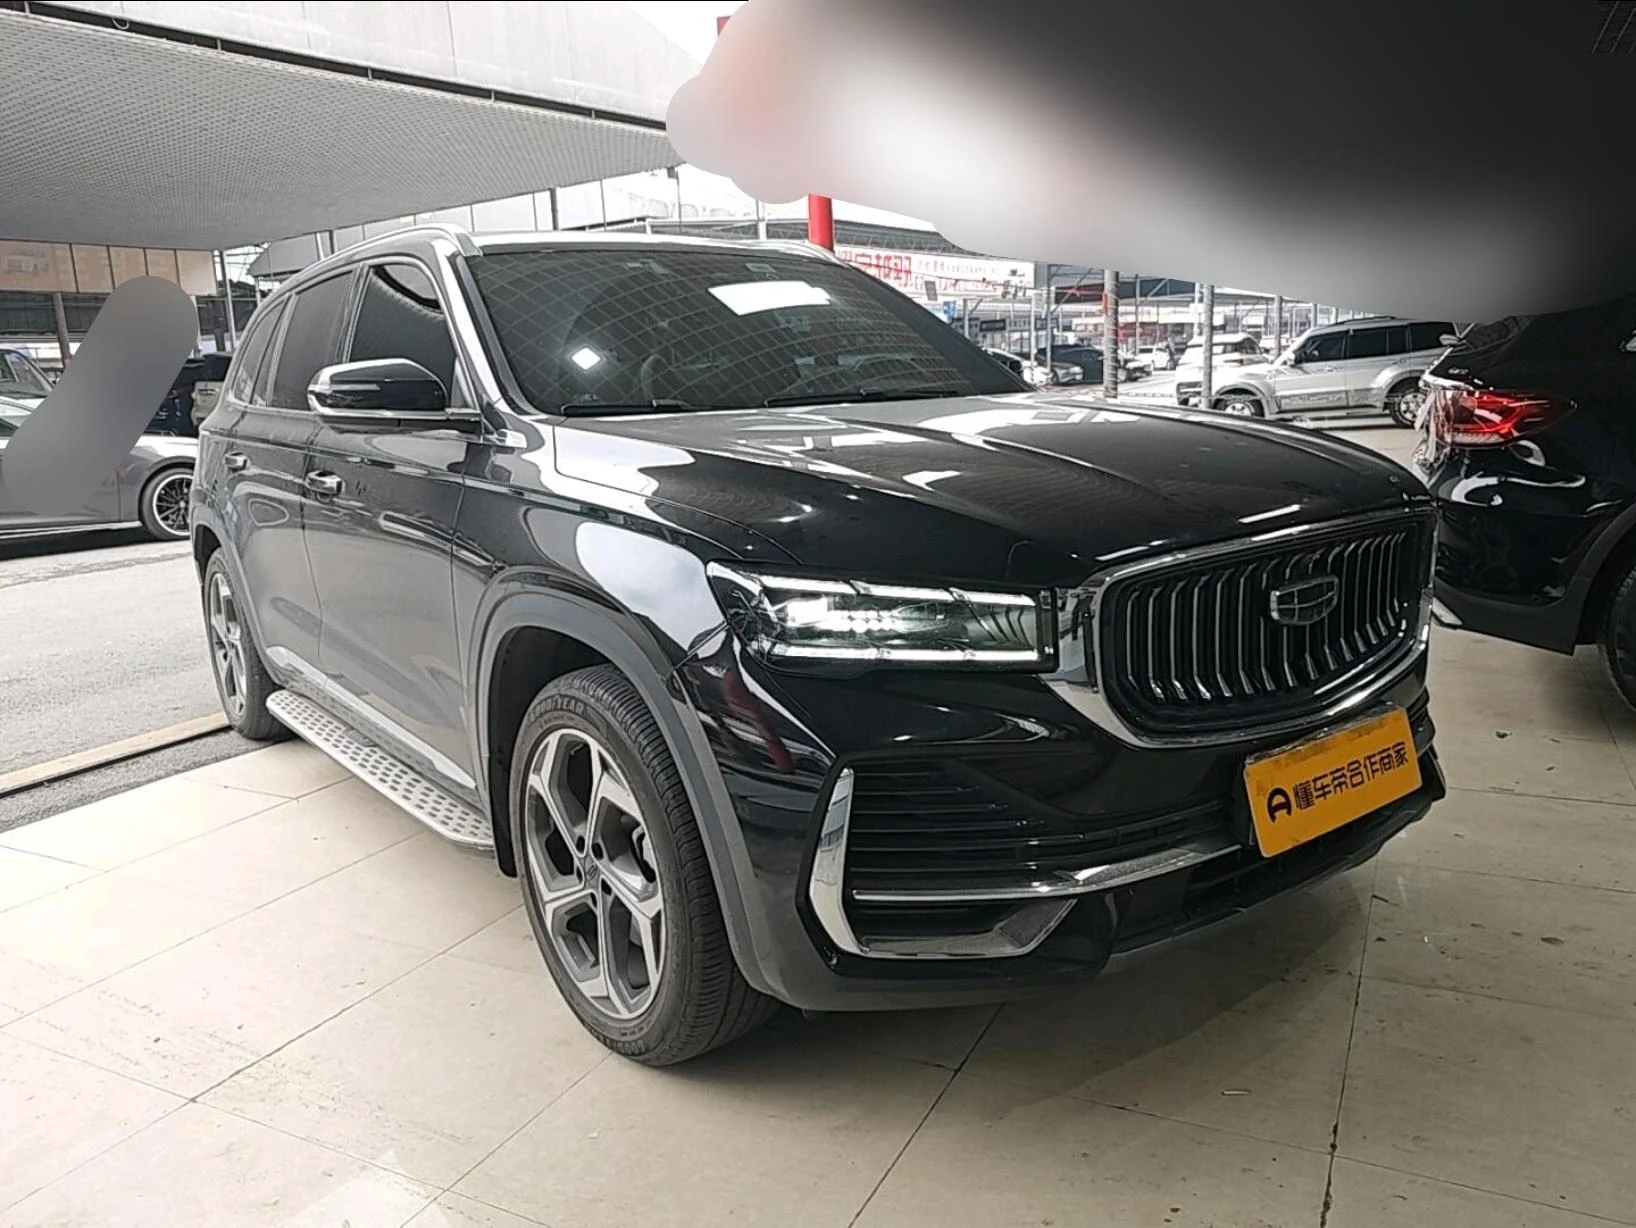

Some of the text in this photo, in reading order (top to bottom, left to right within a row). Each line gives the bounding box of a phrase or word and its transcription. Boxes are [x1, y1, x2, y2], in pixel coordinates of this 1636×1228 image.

[1292, 741, 1409, 810] 懂车帝合作商家
